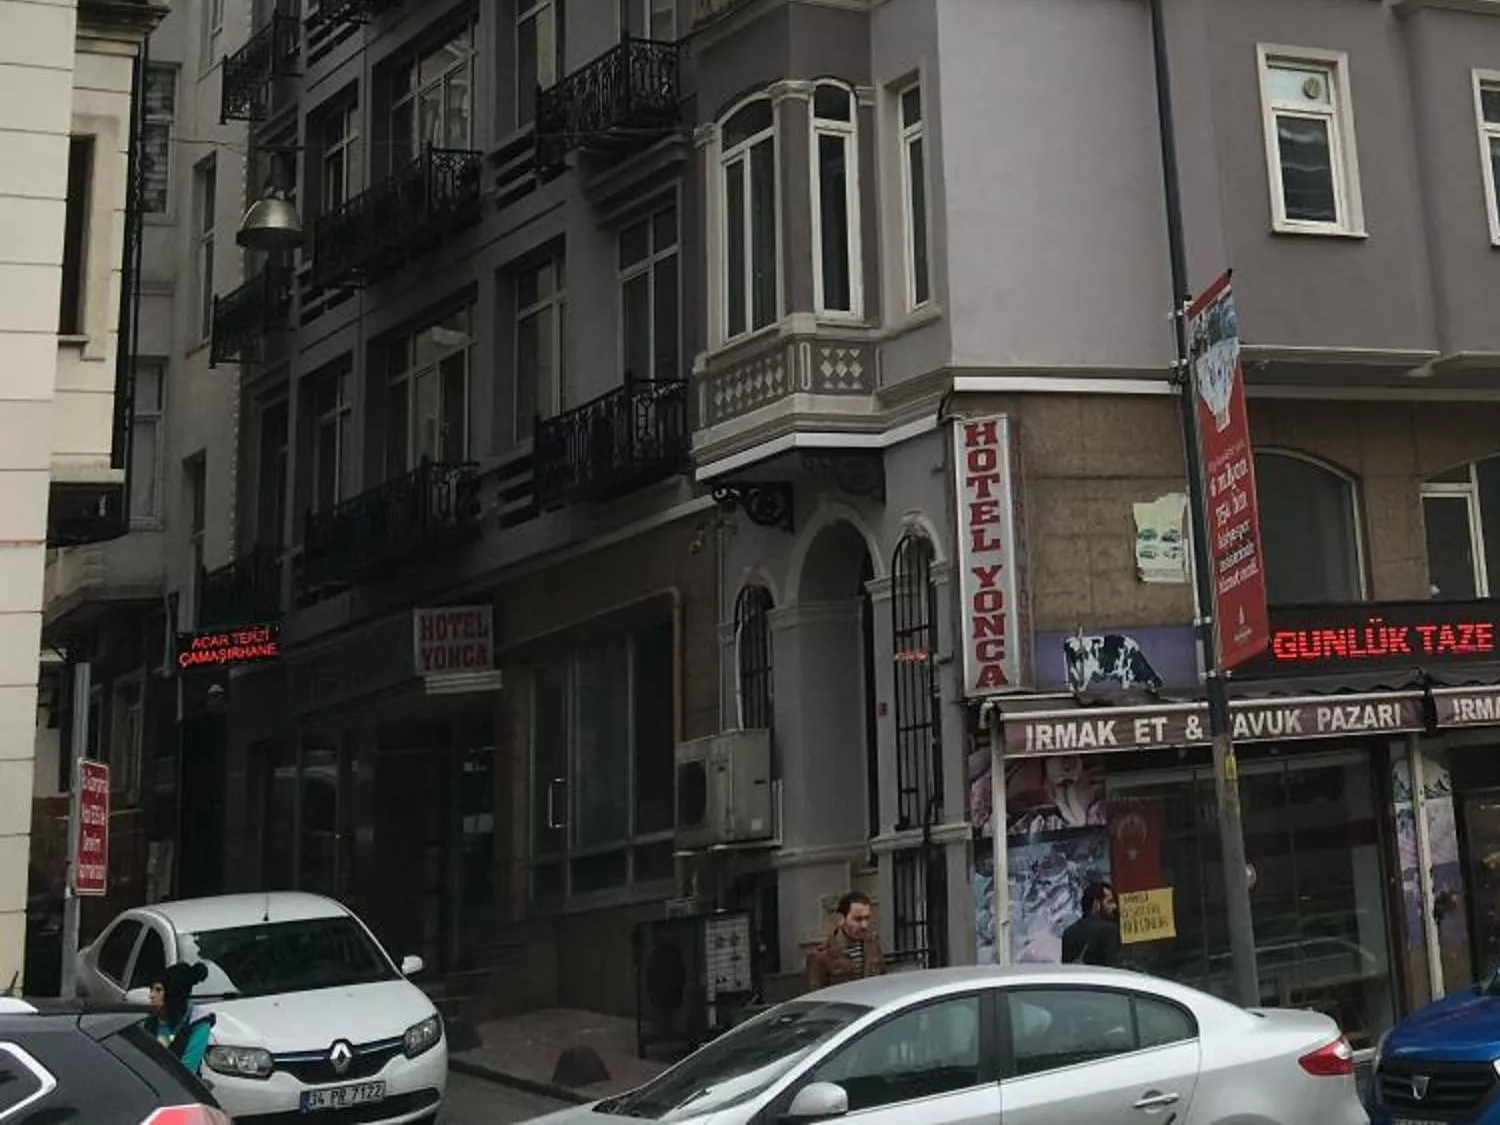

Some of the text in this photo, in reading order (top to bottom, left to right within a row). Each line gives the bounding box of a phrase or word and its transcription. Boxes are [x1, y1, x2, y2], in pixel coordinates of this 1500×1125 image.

[964, 421, 1009, 689] HOTEL YONCA
[420, 611, 488, 642] HOTEL
[1416, 621, 1494, 653] TAZE
[421, 643, 488, 670] YONCA
[1025, 703, 1401, 751] IRMAK ET & AVUK PAZARI
